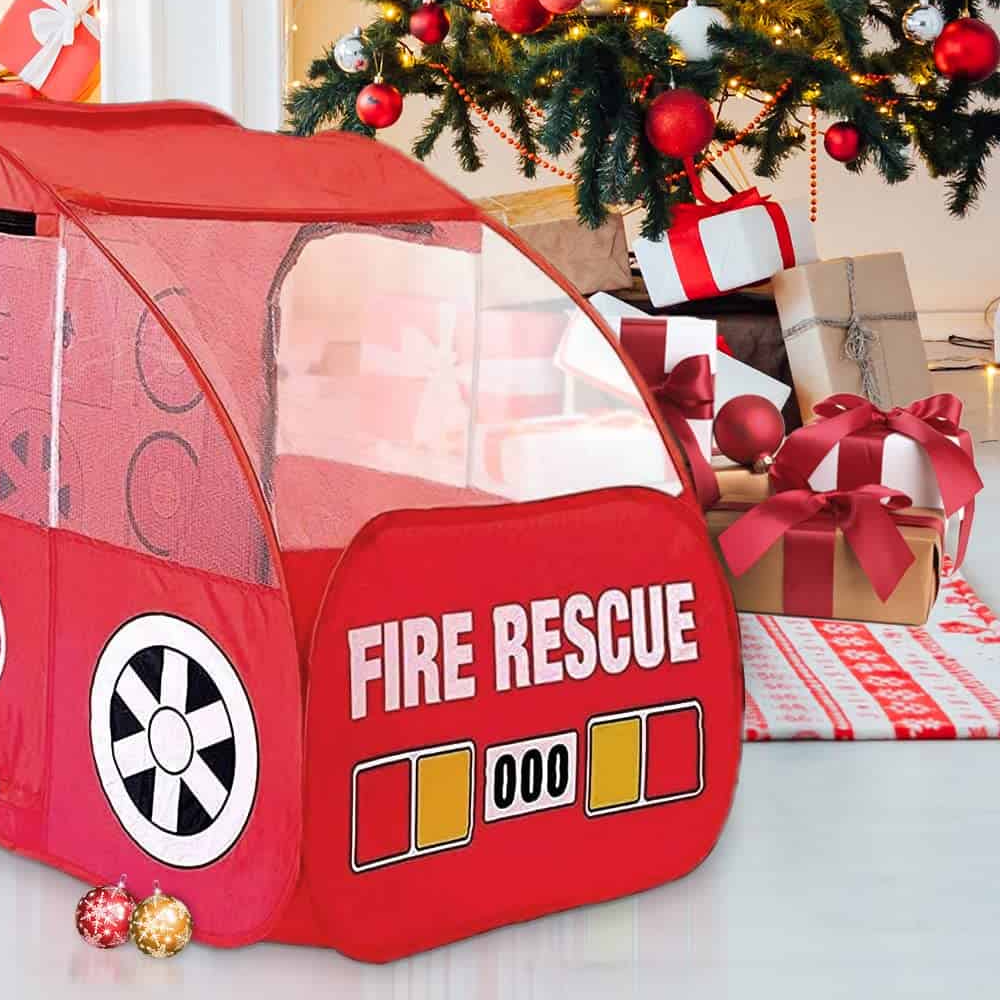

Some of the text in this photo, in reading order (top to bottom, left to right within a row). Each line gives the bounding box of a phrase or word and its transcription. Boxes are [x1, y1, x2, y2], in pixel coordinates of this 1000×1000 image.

[347, 582, 699, 720] FIRE RESCUE
[493, 743, 569, 810] 000
